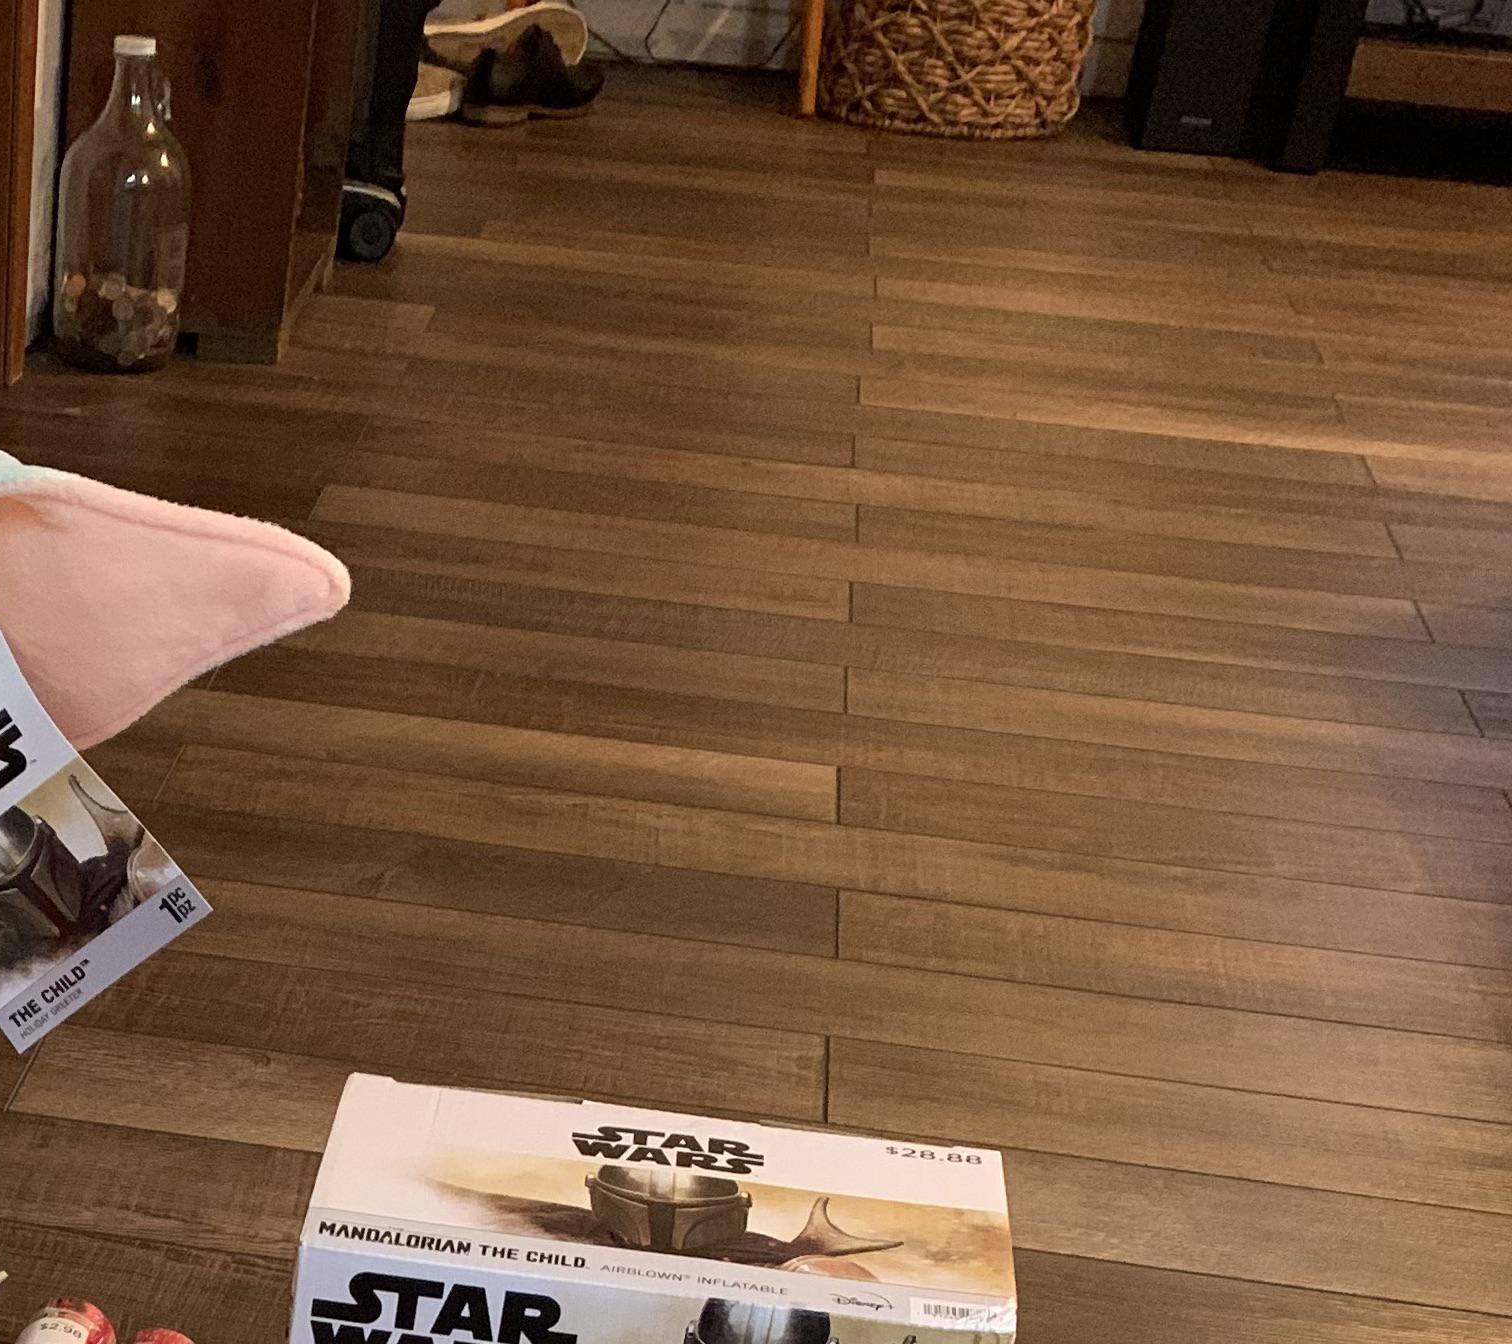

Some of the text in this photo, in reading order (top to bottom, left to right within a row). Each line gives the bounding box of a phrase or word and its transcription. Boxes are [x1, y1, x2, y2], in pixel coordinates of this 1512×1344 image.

[8, 999, 42, 1027] THE
[572, 1126, 764, 1160] STAR
[572, 1139, 764, 1174] WARS
[885, 1145, 983, 1166] $28.88
[318, 1221, 471, 1255] MANDALORIAN
[478, 1244, 520, 1260] THE
[696, 1276, 788, 1296] INFLATABLE
[39, 1321, 82, 1339] $2.98
